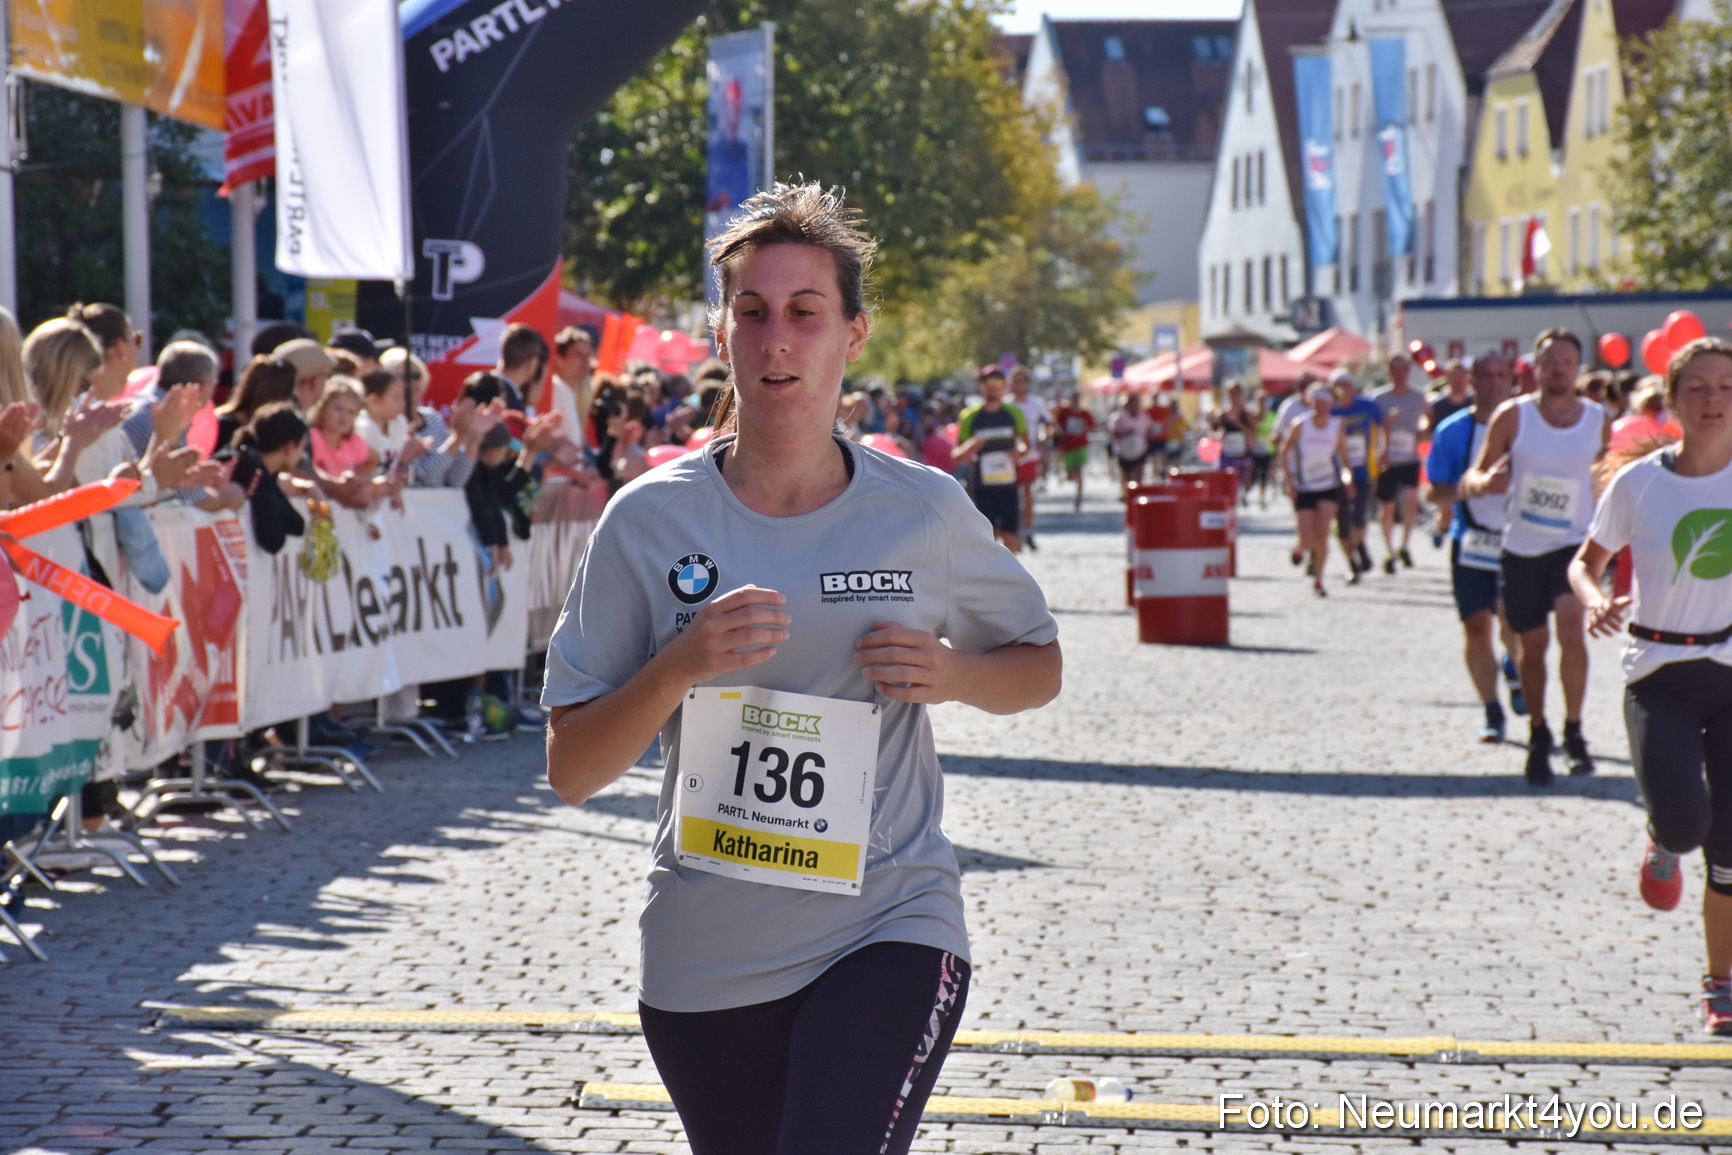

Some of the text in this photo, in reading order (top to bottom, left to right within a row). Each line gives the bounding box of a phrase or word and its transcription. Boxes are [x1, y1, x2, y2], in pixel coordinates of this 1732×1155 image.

[429, 0, 547, 73] PARTL
[1528, 487, 1570, 511] 3092
[673, 554, 715, 573] BMW
[24, 556, 113, 616] DEHN
[820, 570, 914, 594] BOCK
[821, 594, 915, 604] inspired by smart concepts
[742, 704, 822, 735] BOCK
[740, 724, 822, 744] inspired by smart concepts
[689, 778, 697, 788] D
[730, 740, 826, 809] 136
[718, 803, 748, 820] PARTL
[751, 811, 810, 830] Neumarkt
[713, 828, 819, 869] Katharina
